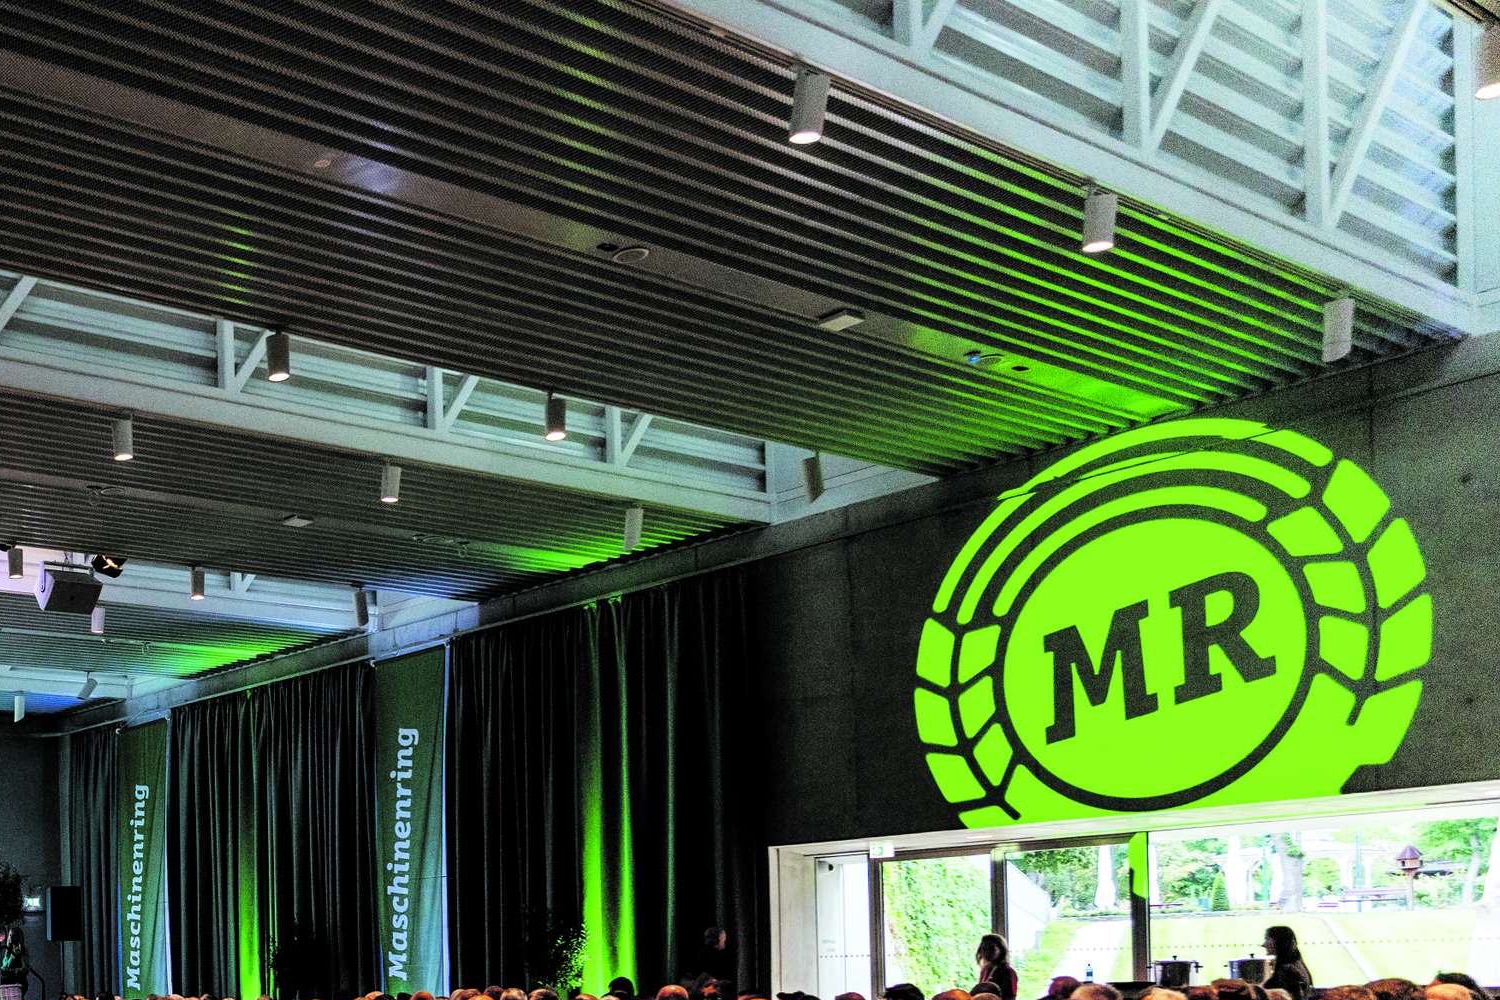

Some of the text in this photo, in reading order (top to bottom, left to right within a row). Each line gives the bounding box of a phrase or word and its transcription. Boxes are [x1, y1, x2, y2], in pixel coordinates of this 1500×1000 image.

[1043, 571, 1277, 745] MR
[125, 783, 150, 991] Maschinenring
[386, 726, 420, 981] Maschinenring
